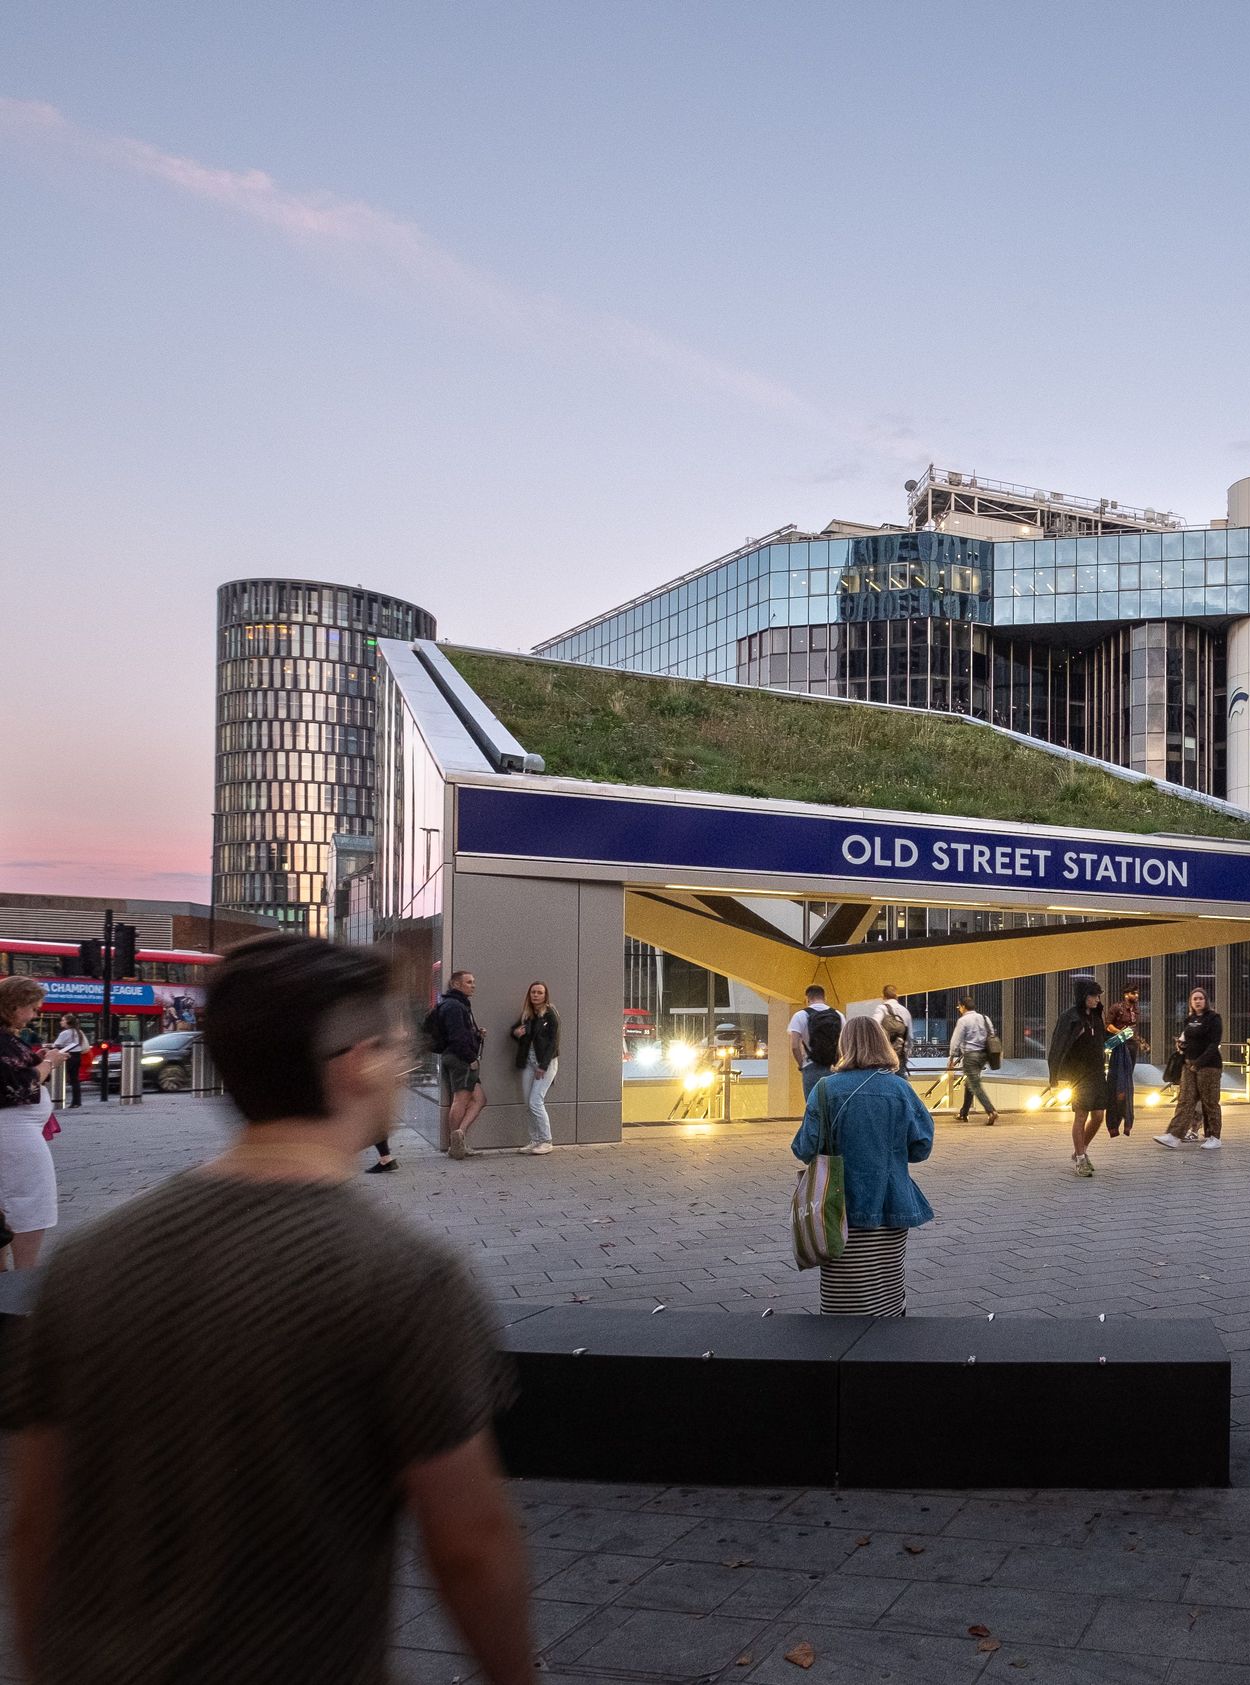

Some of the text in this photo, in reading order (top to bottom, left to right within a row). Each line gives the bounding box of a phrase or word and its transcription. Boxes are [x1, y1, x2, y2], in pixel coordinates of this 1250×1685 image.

[841, 834, 1188, 887] OLD STREET STATION
[50, 983, 104, 994] CHAMPIONS
[110, 985, 144, 996] EAGUE
